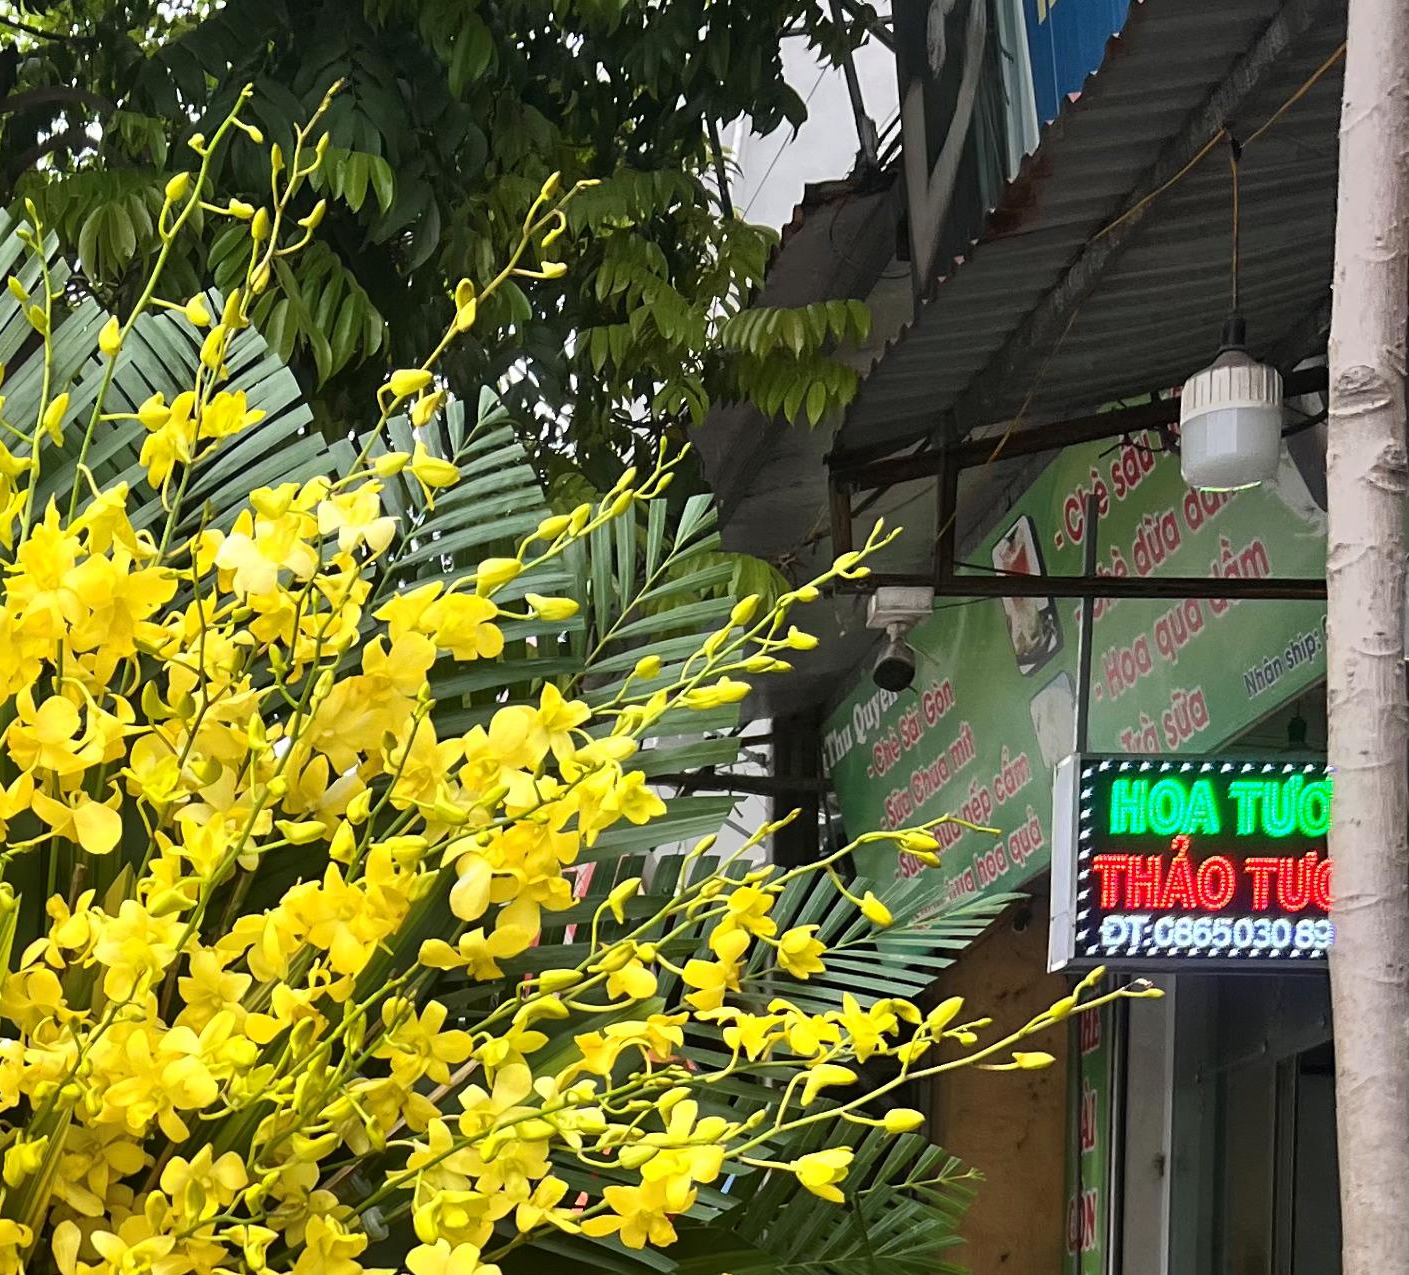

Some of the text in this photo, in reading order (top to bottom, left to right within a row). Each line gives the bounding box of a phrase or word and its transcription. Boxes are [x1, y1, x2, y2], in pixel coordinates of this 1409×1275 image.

[1108, 773, 1334, 839] HOA TƯƠ
[1092, 834, 1237, 912] THẢO
